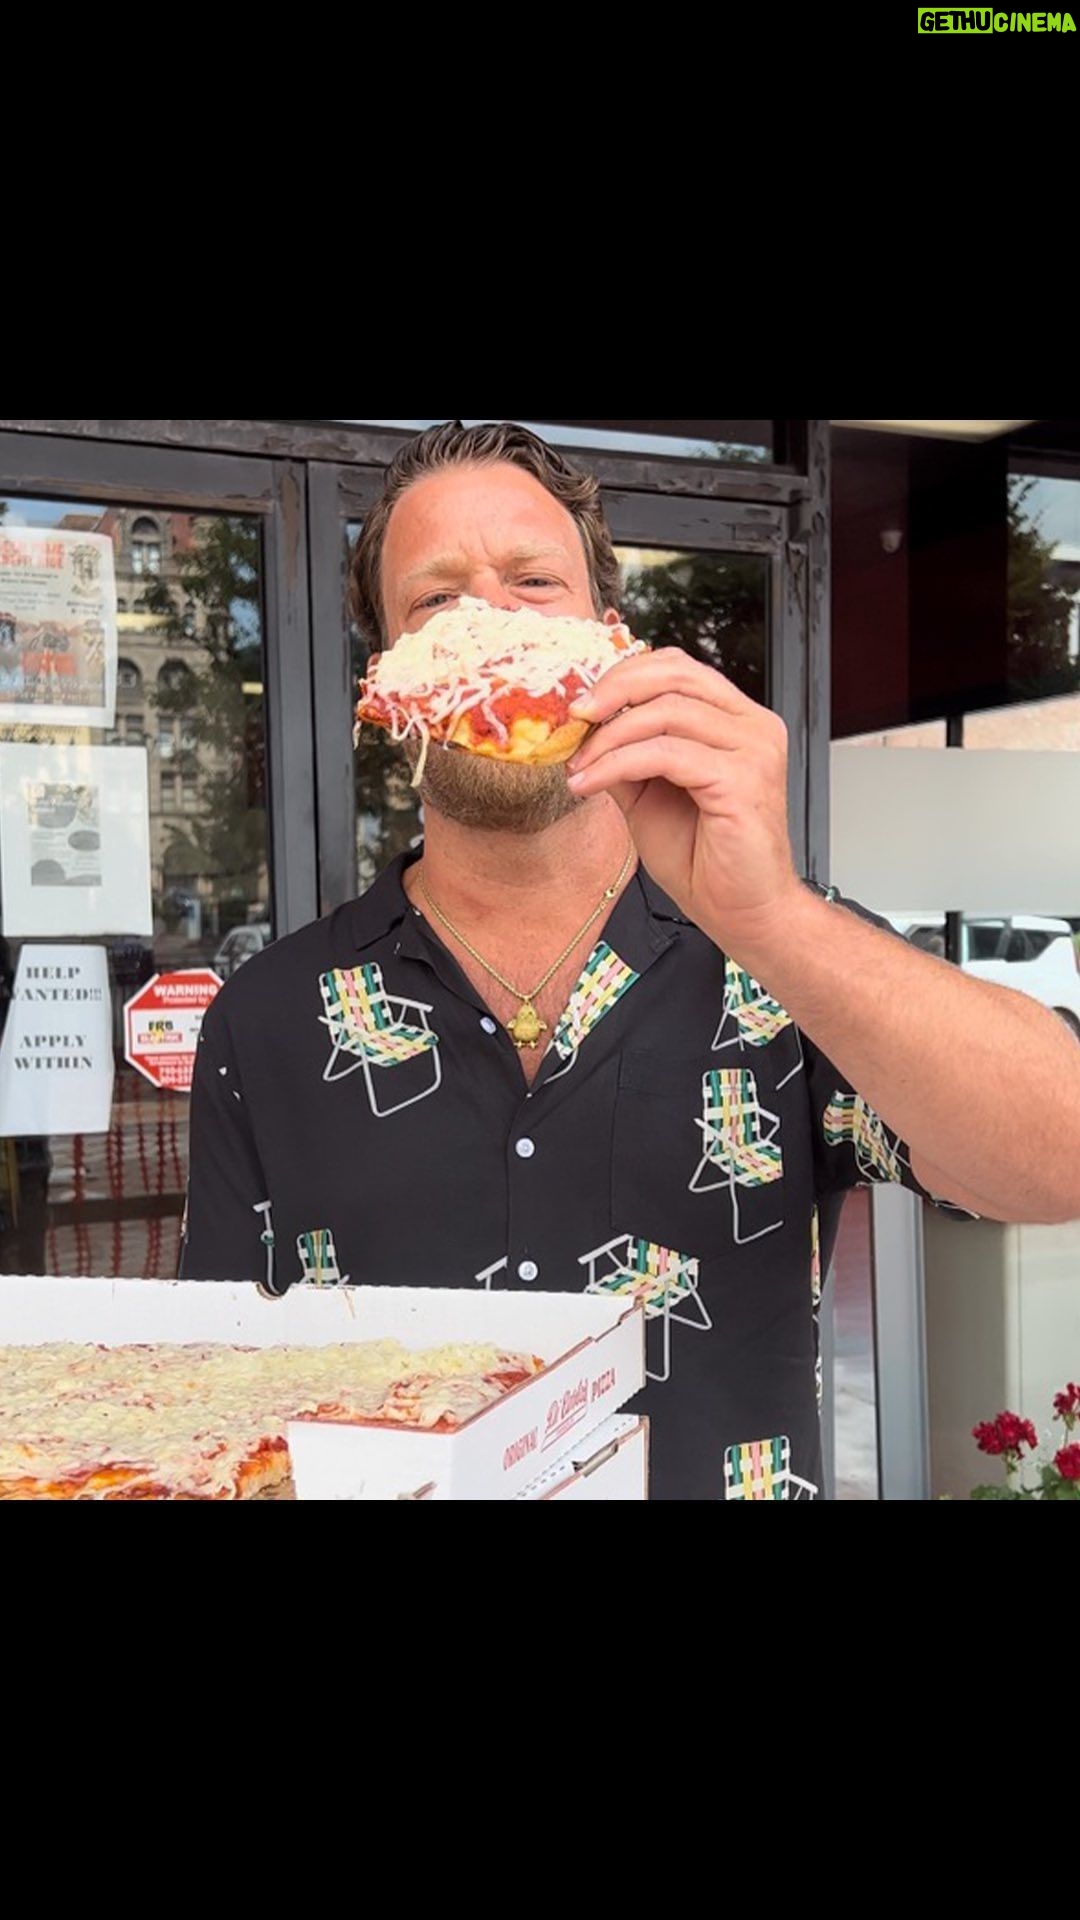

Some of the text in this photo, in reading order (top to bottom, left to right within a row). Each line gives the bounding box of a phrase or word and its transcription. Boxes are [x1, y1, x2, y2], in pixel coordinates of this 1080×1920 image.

[26, 967, 80, 979] HELP
[154, 984, 218, 997] WARNING
[20, 1035, 87, 1048] APPLY
[14, 1057, 92, 1069] WITHIN
[591, 1368, 615, 1402] PIZZA
